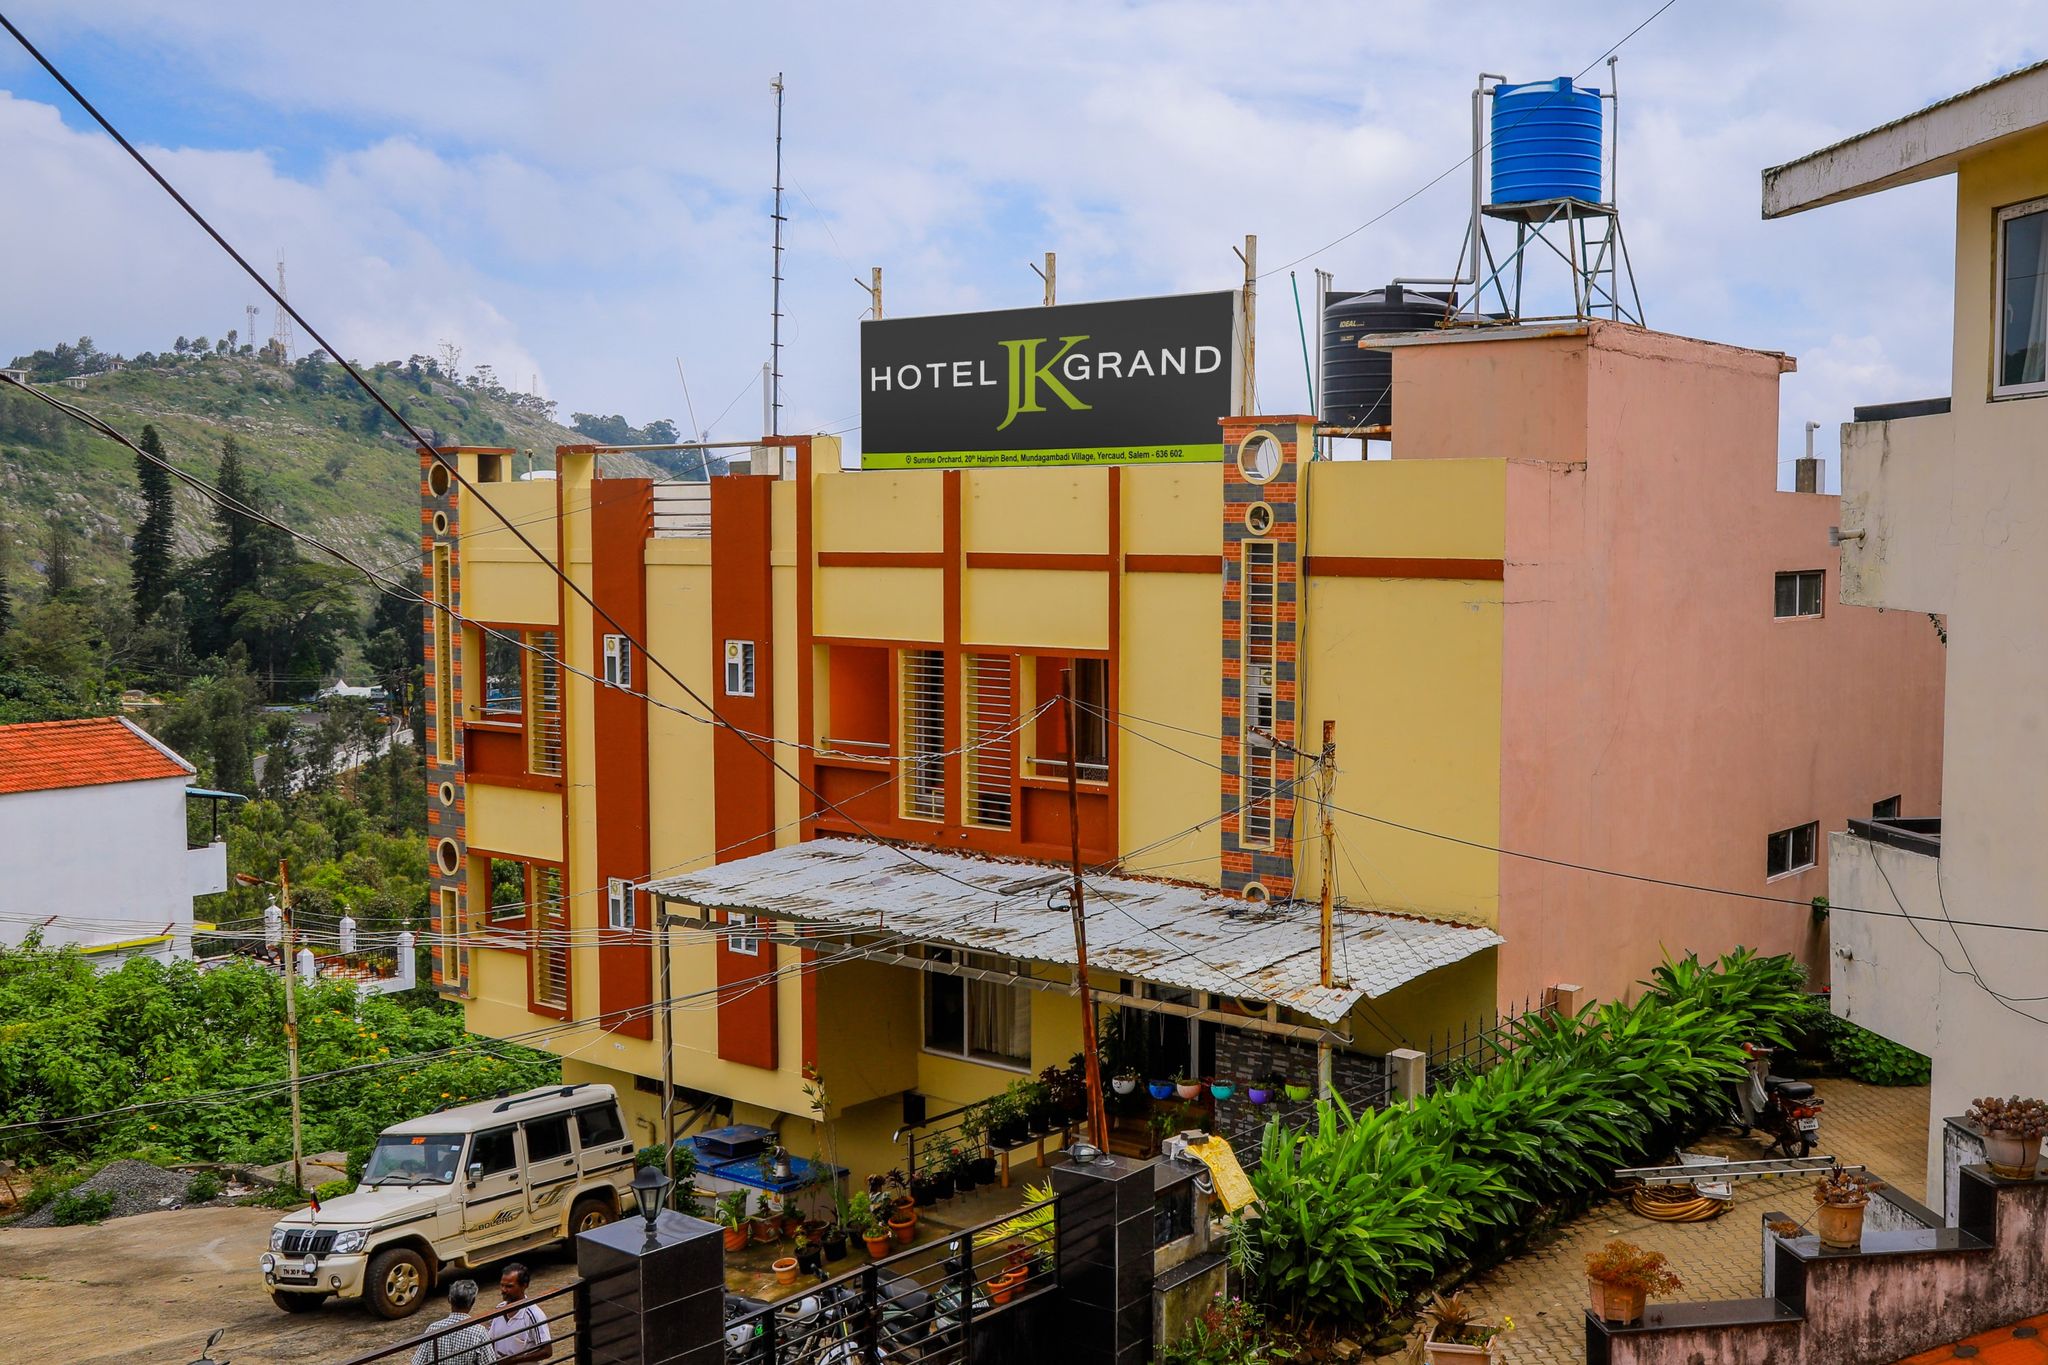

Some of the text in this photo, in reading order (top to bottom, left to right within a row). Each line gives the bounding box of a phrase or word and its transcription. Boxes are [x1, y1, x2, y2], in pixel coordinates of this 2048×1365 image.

[871, 335, 1222, 432] HOTEL JK GRAND
[913, 455, 937, 464] Sunrise
[937, 455, 963, 464] Orchard,
[976, 454, 999, 464] Hairpin
[1000, 454, 1019, 463] Bend,
[1021, 452, 1069, 464] Mundagambadi
[1071, 452, 1095, 462] Village,
[1097, 451, 1126, 461] Yercaud,
[1128, 450, 1149, 459] Salem
[1155, 450, 1168, 458] 636
[1170, 449, 1184, 458] 602.
[283, 1268, 290, 1276] TN
